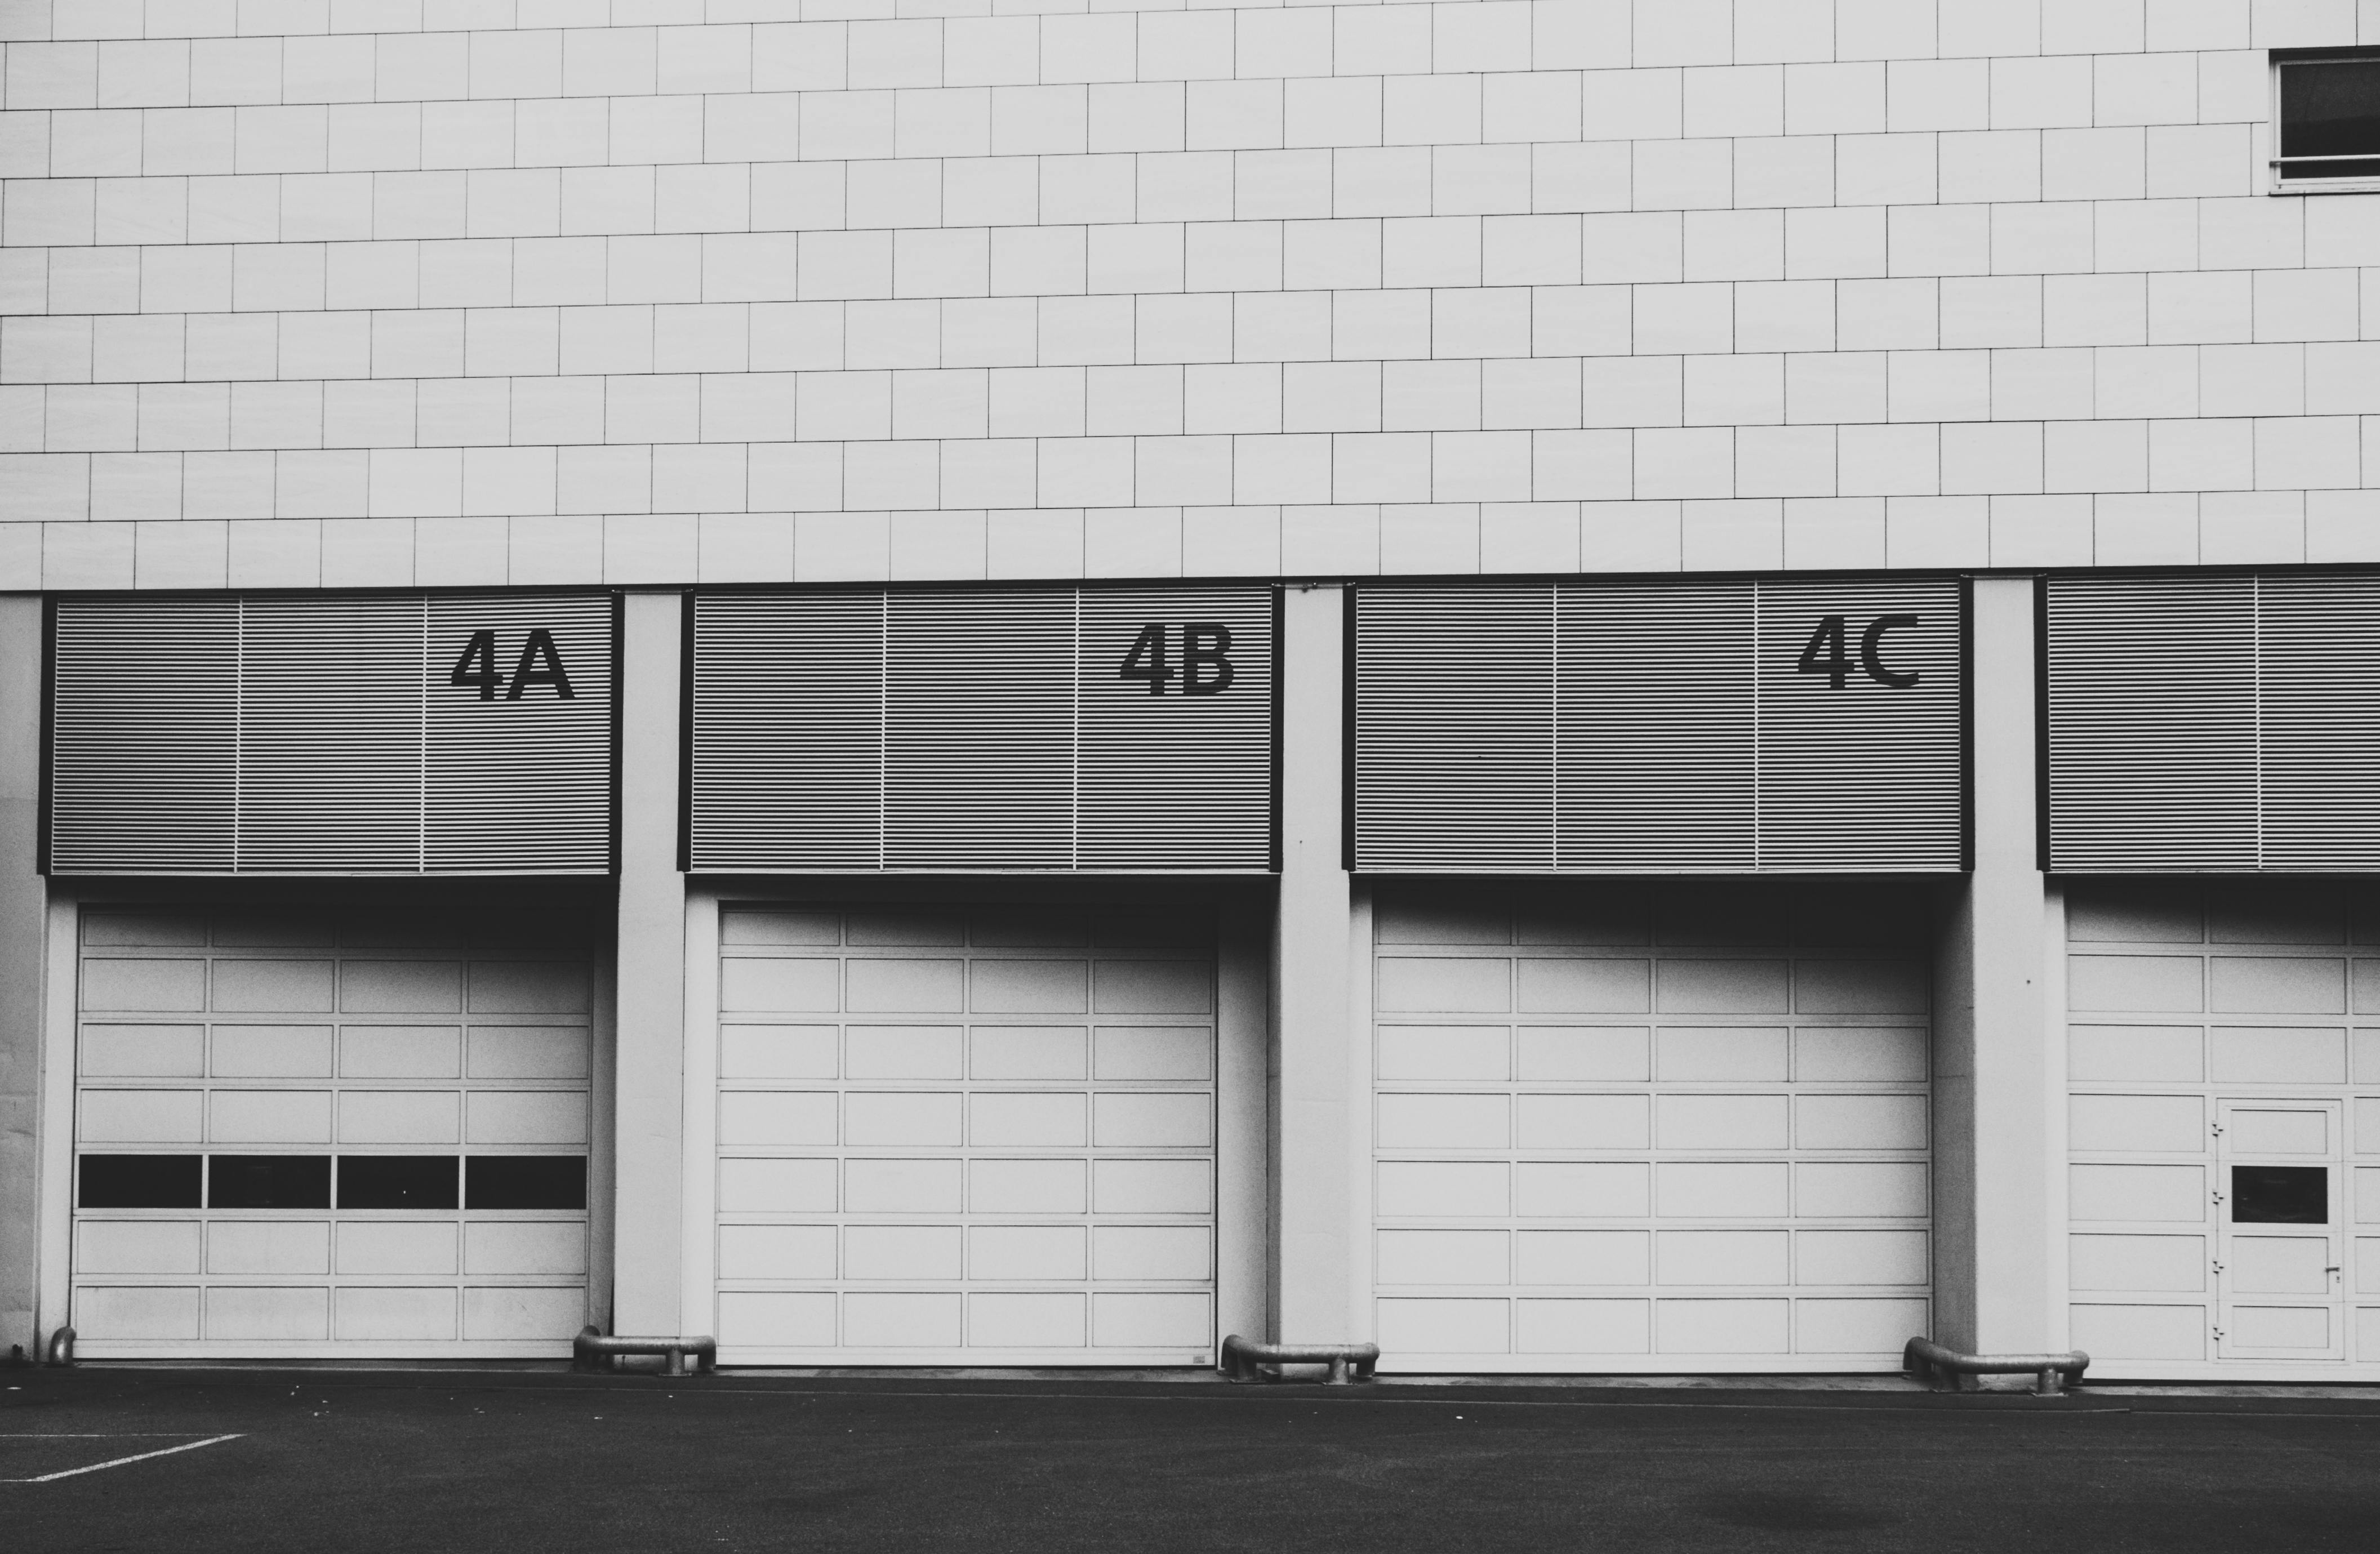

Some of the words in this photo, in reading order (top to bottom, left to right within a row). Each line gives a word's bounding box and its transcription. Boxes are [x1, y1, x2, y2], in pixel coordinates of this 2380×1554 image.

[451, 629, 576, 701] 4A
[1120, 624, 1234, 696] 4B
[1798, 615, 1920, 689] 4C
